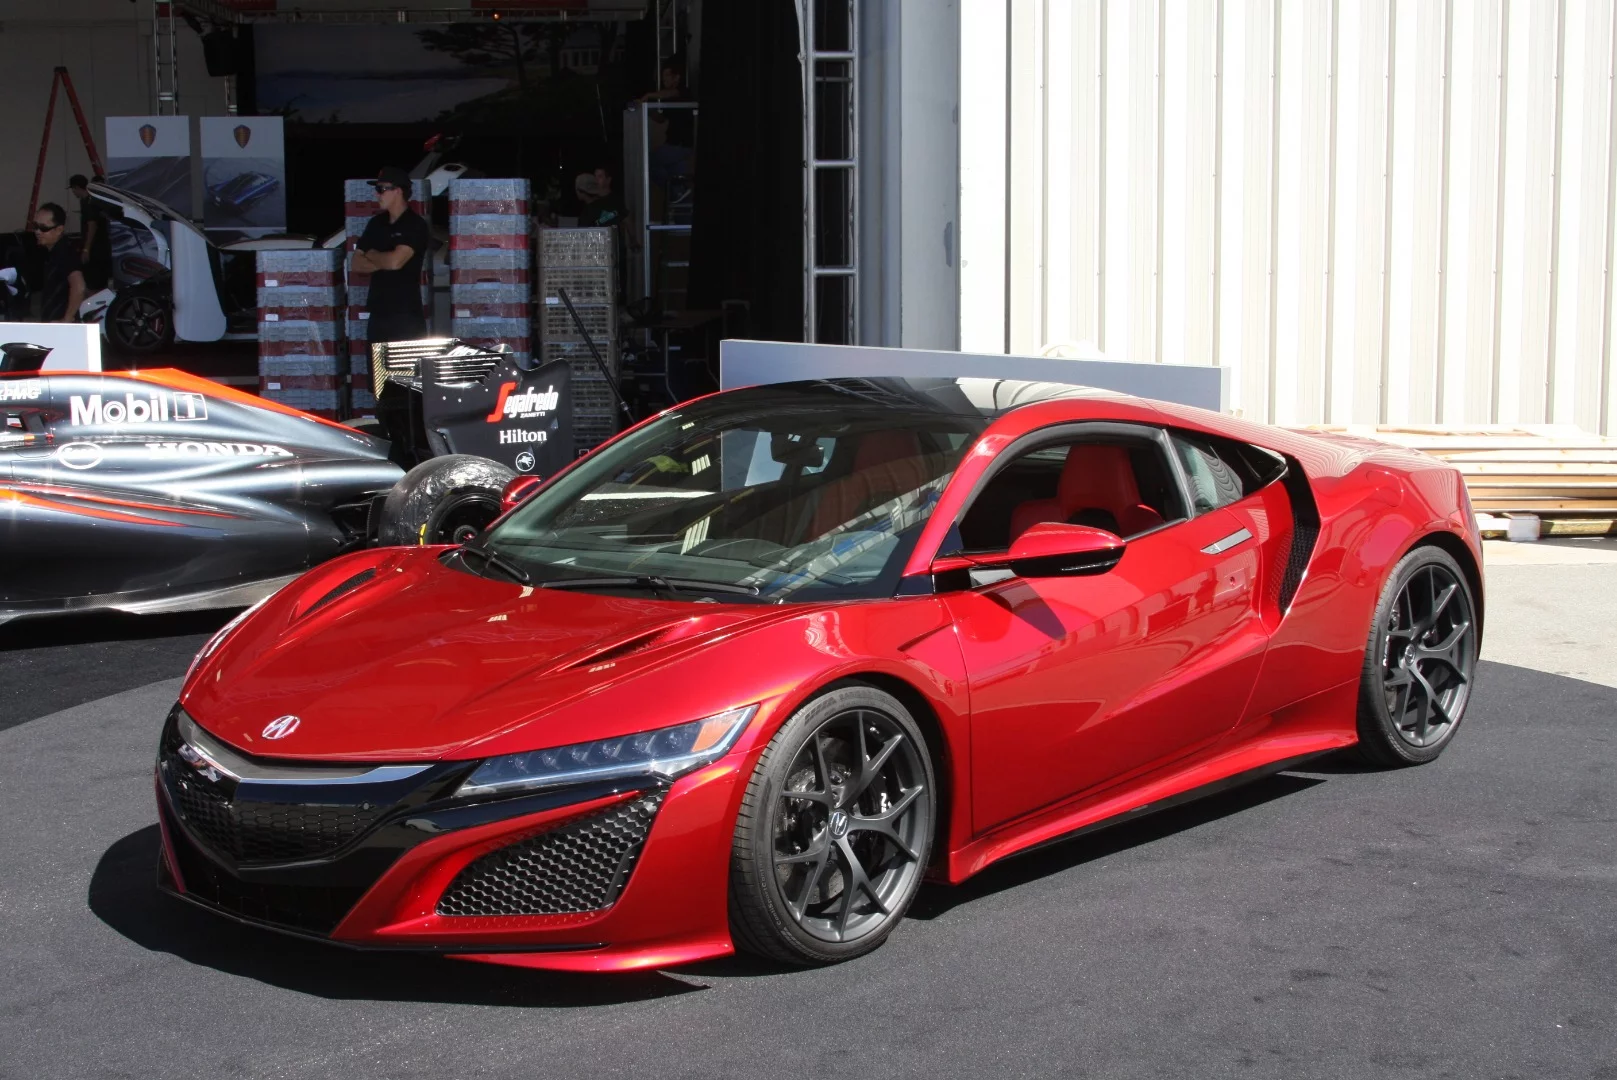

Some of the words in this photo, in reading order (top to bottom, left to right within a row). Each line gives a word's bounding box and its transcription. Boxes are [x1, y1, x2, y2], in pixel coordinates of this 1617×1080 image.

[70, 391, 168, 426] Mobil
[487, 383, 559, 423] Segafredo
[500, 429, 547, 444] Hilton
[145, 442, 294, 458] HONDA
